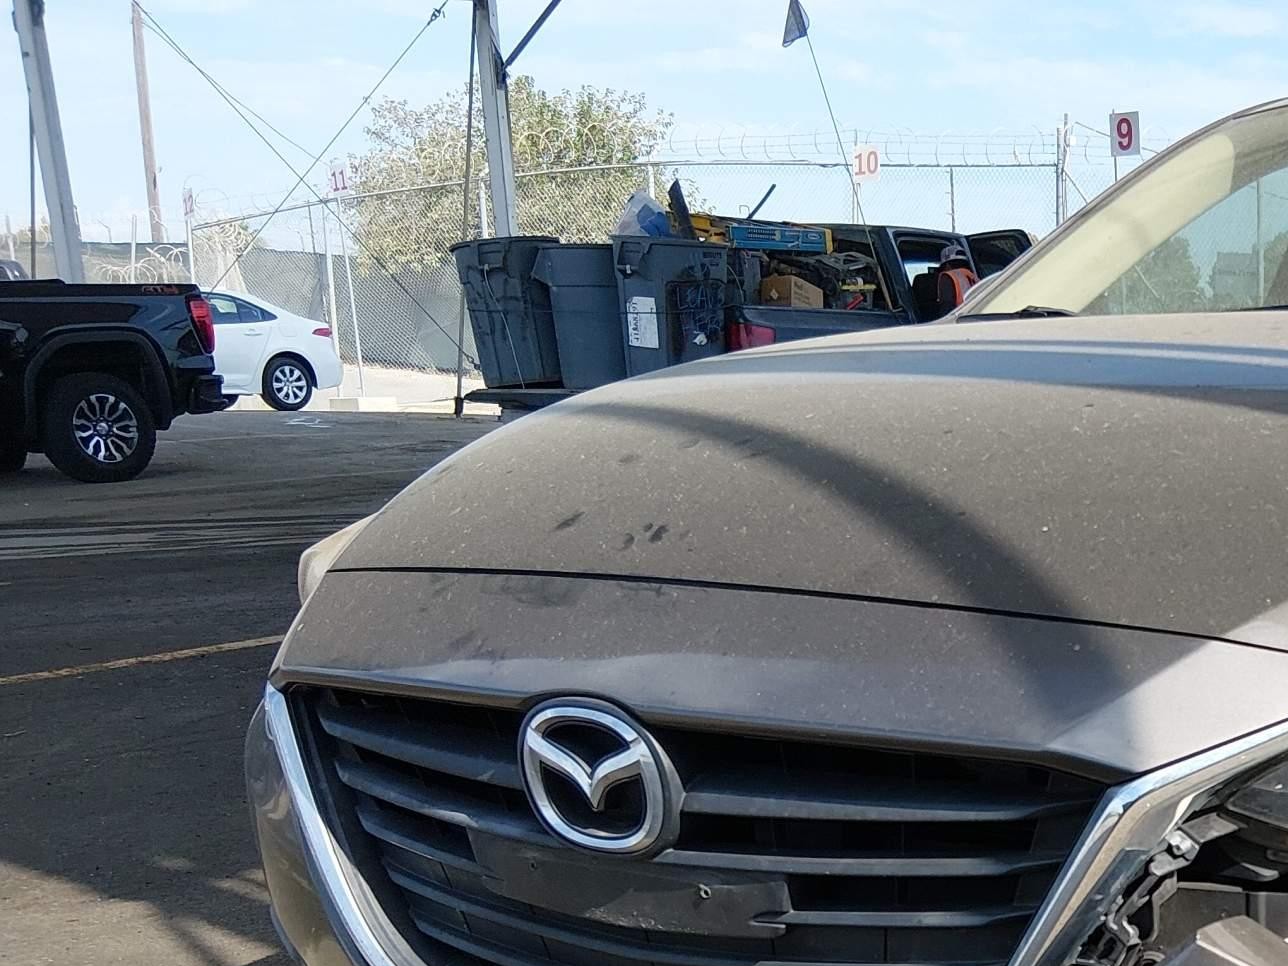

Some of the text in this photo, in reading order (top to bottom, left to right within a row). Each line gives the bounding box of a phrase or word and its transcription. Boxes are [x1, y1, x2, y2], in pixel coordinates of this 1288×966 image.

[1116, 117, 1133, 151] 9
[854, 150, 879, 176] 10
[331, 169, 348, 192] 11
